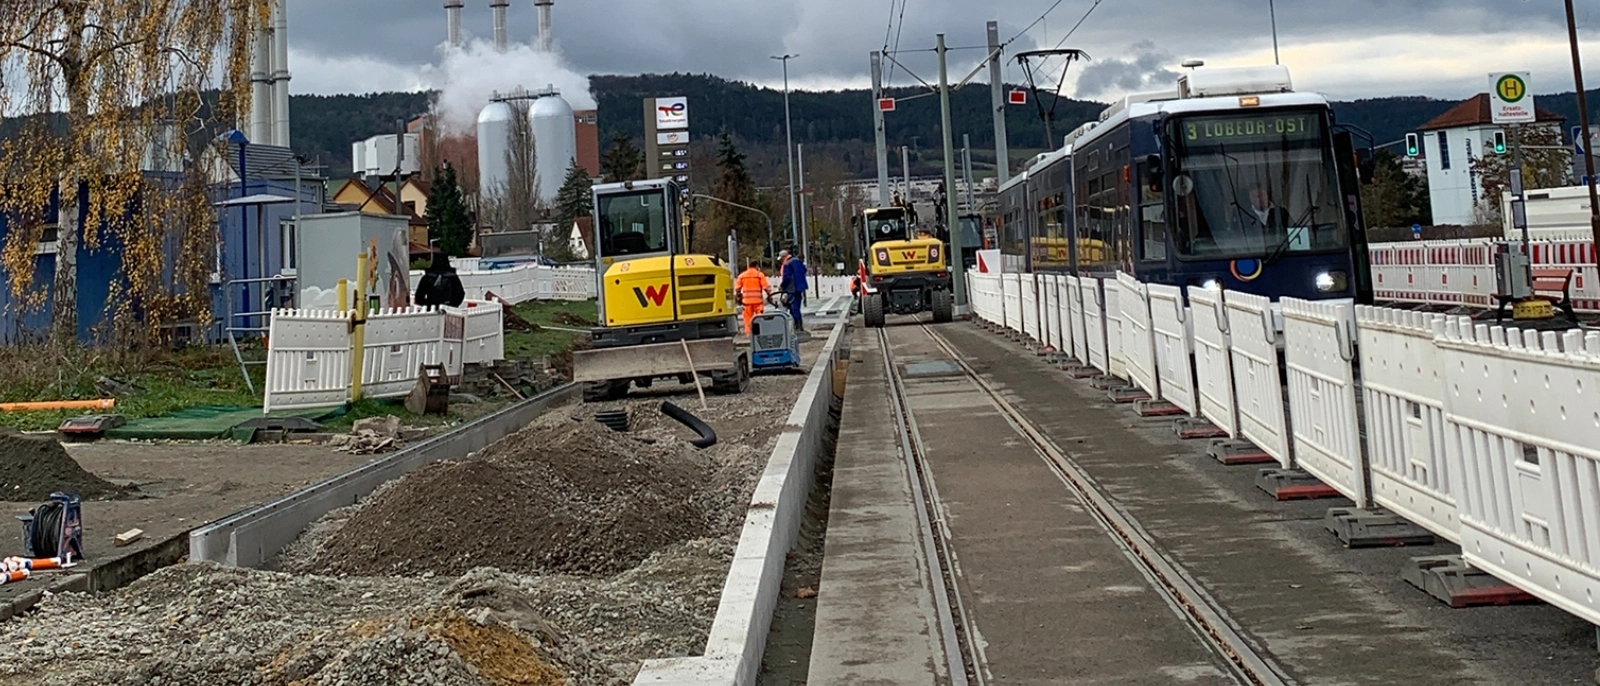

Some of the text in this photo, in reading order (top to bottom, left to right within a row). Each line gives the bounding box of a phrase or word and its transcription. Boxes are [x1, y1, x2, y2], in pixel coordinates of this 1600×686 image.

[1504, 81, 1517, 97] H
[1187, 118, 1305, 140] 3 LOBEDA-OST
